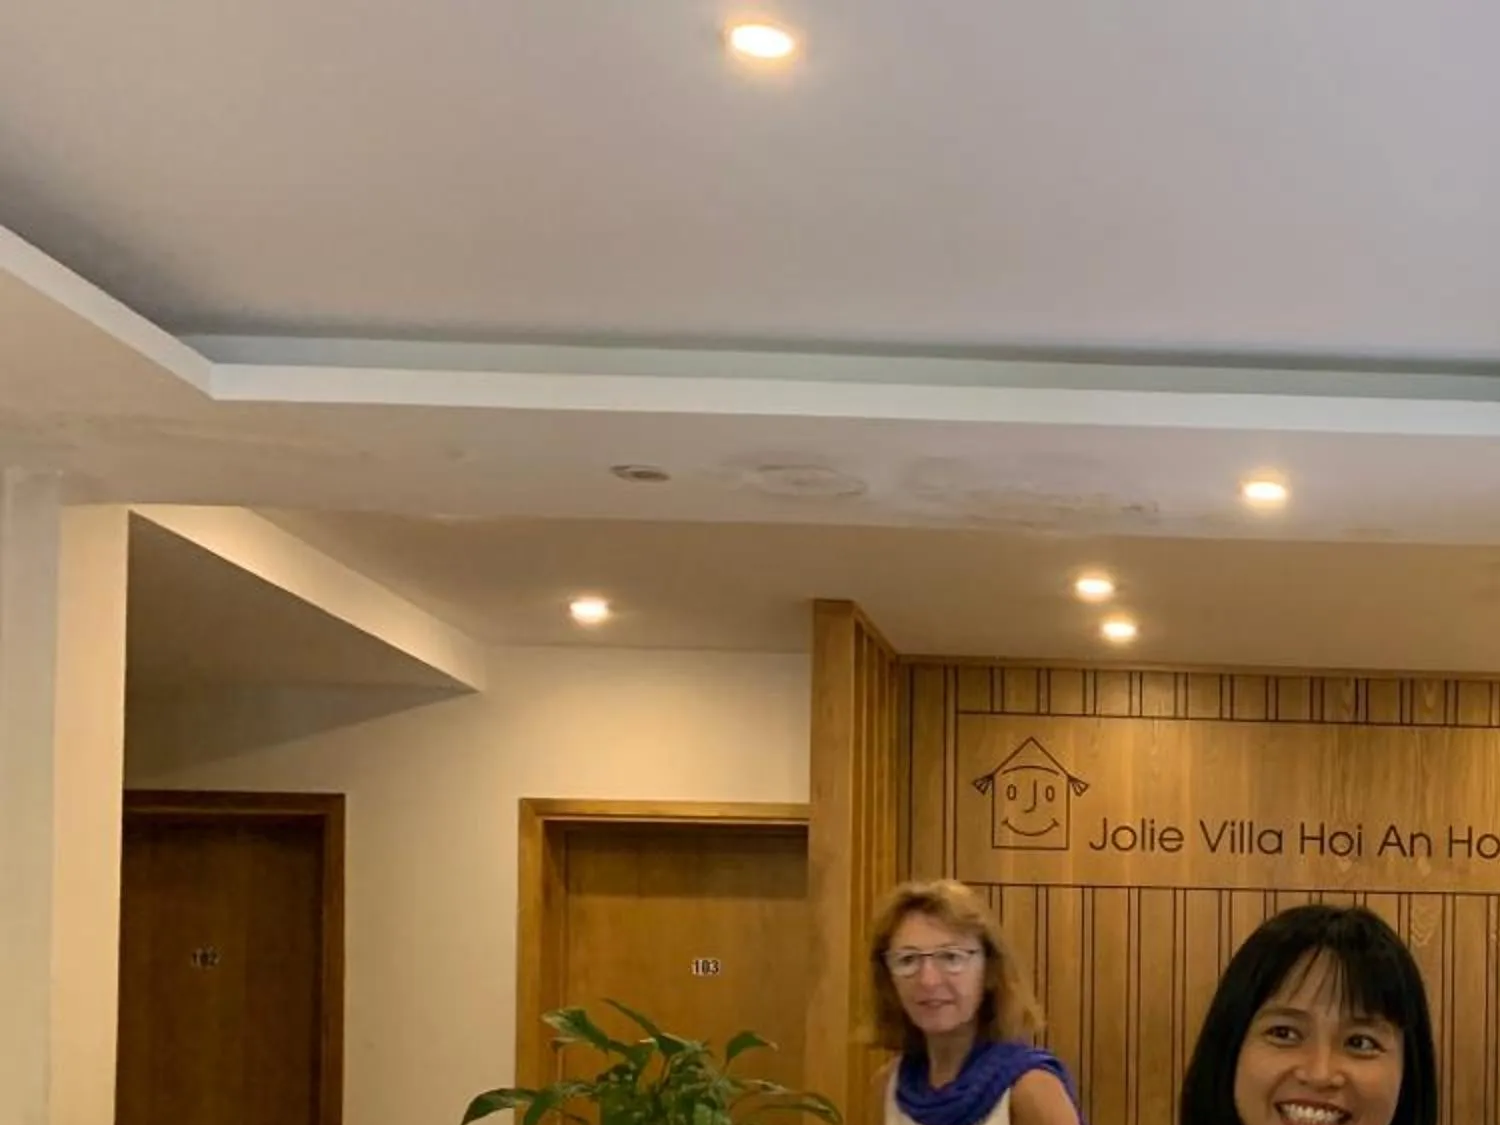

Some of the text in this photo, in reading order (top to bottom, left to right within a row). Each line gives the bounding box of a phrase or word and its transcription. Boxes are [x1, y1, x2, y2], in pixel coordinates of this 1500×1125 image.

[1088, 816, 1185, 852] Jolie
[1198, 819, 1284, 855] Villa
[1298, 821, 1364, 857] Hoi
[1376, 824, 1433, 858] An
[691, 958, 720, 977] 103
